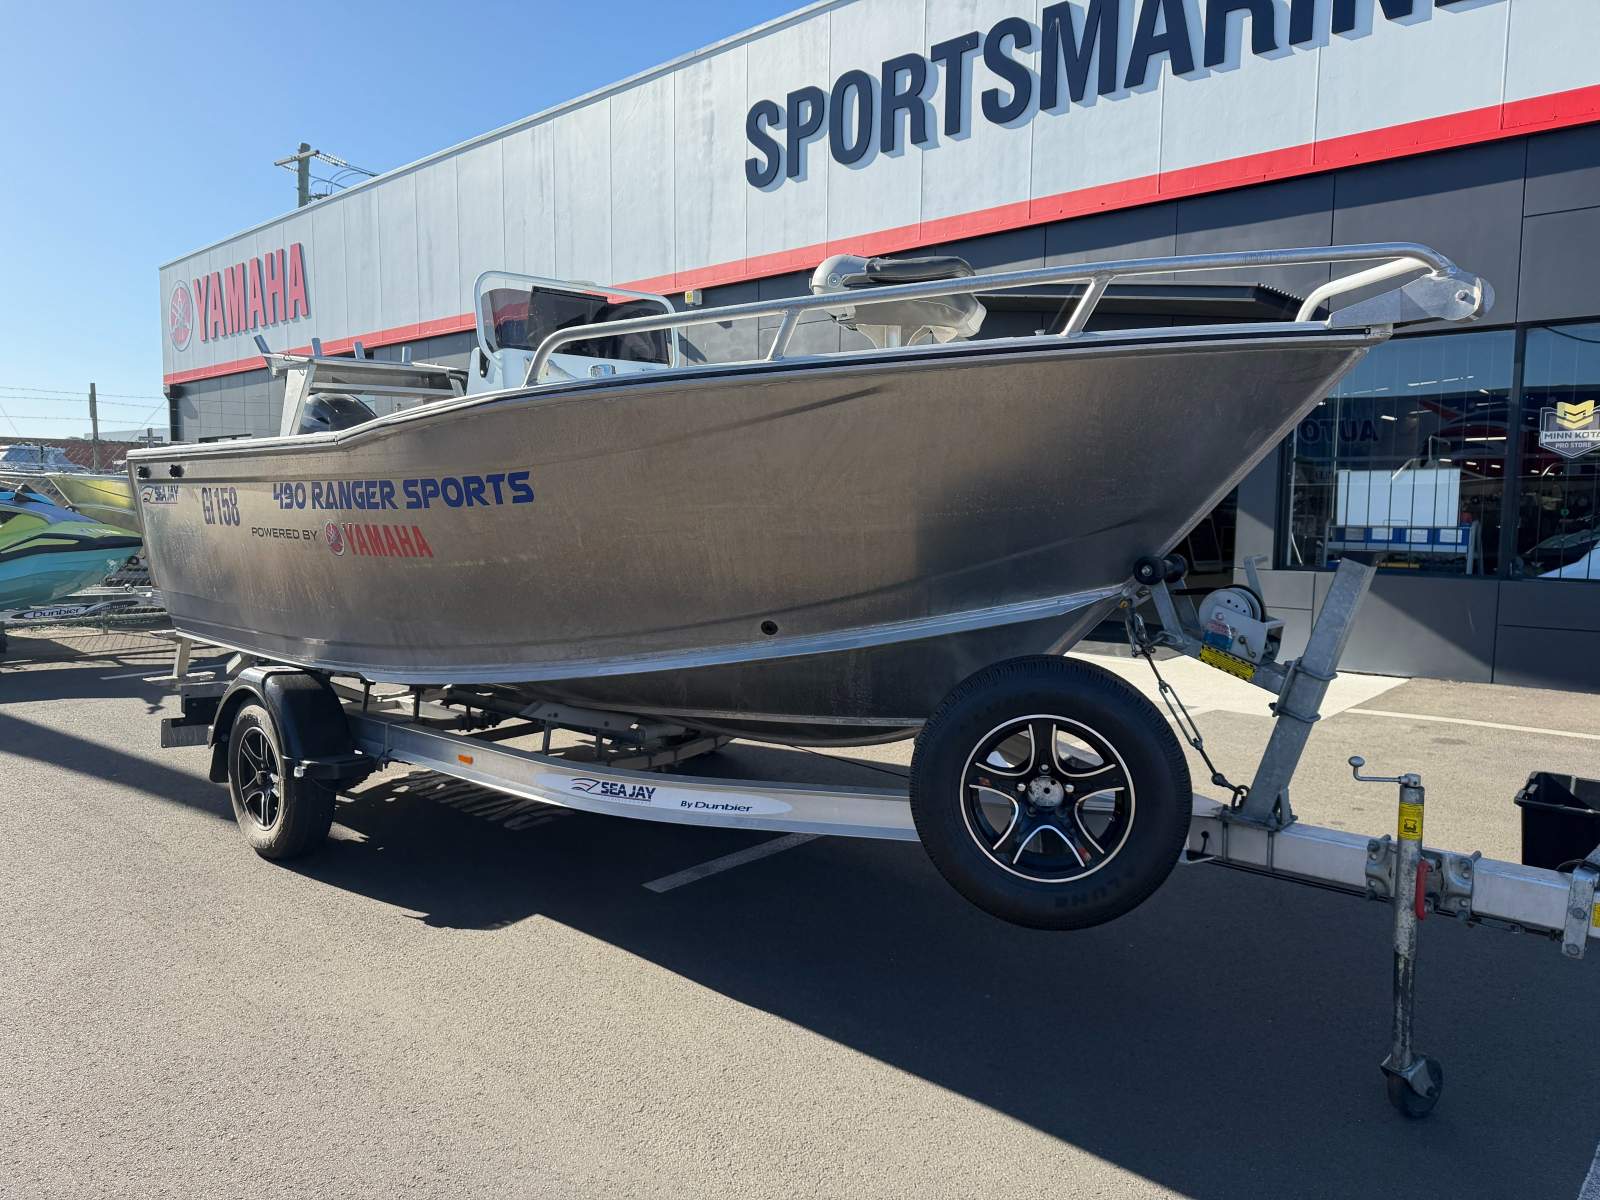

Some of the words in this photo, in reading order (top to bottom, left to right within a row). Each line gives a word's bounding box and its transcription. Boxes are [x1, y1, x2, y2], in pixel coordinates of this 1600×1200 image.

[744, 0, 1466, 189] SPORTSMAR
[193, 242, 309, 342] YAMAHA
[1543, 431, 1572, 440] MINN
[1570, 441, 1592, 449] STORE
[273, 481, 307, 510] 490
[311, 480, 399, 510] RANGER
[402, 471, 535, 510] SPORTS
[251, 526, 300, 540] POWERED
[301, 529, 318, 541] BY
[340, 523, 434, 558] YAMAHA
[33, 608, 80, 618] Dunbier
[600, 781, 628, 797] SEA
[628, 785, 657, 800] JAY
[680, 800, 693, 809] By
[694, 801, 753, 812] Dunbier
